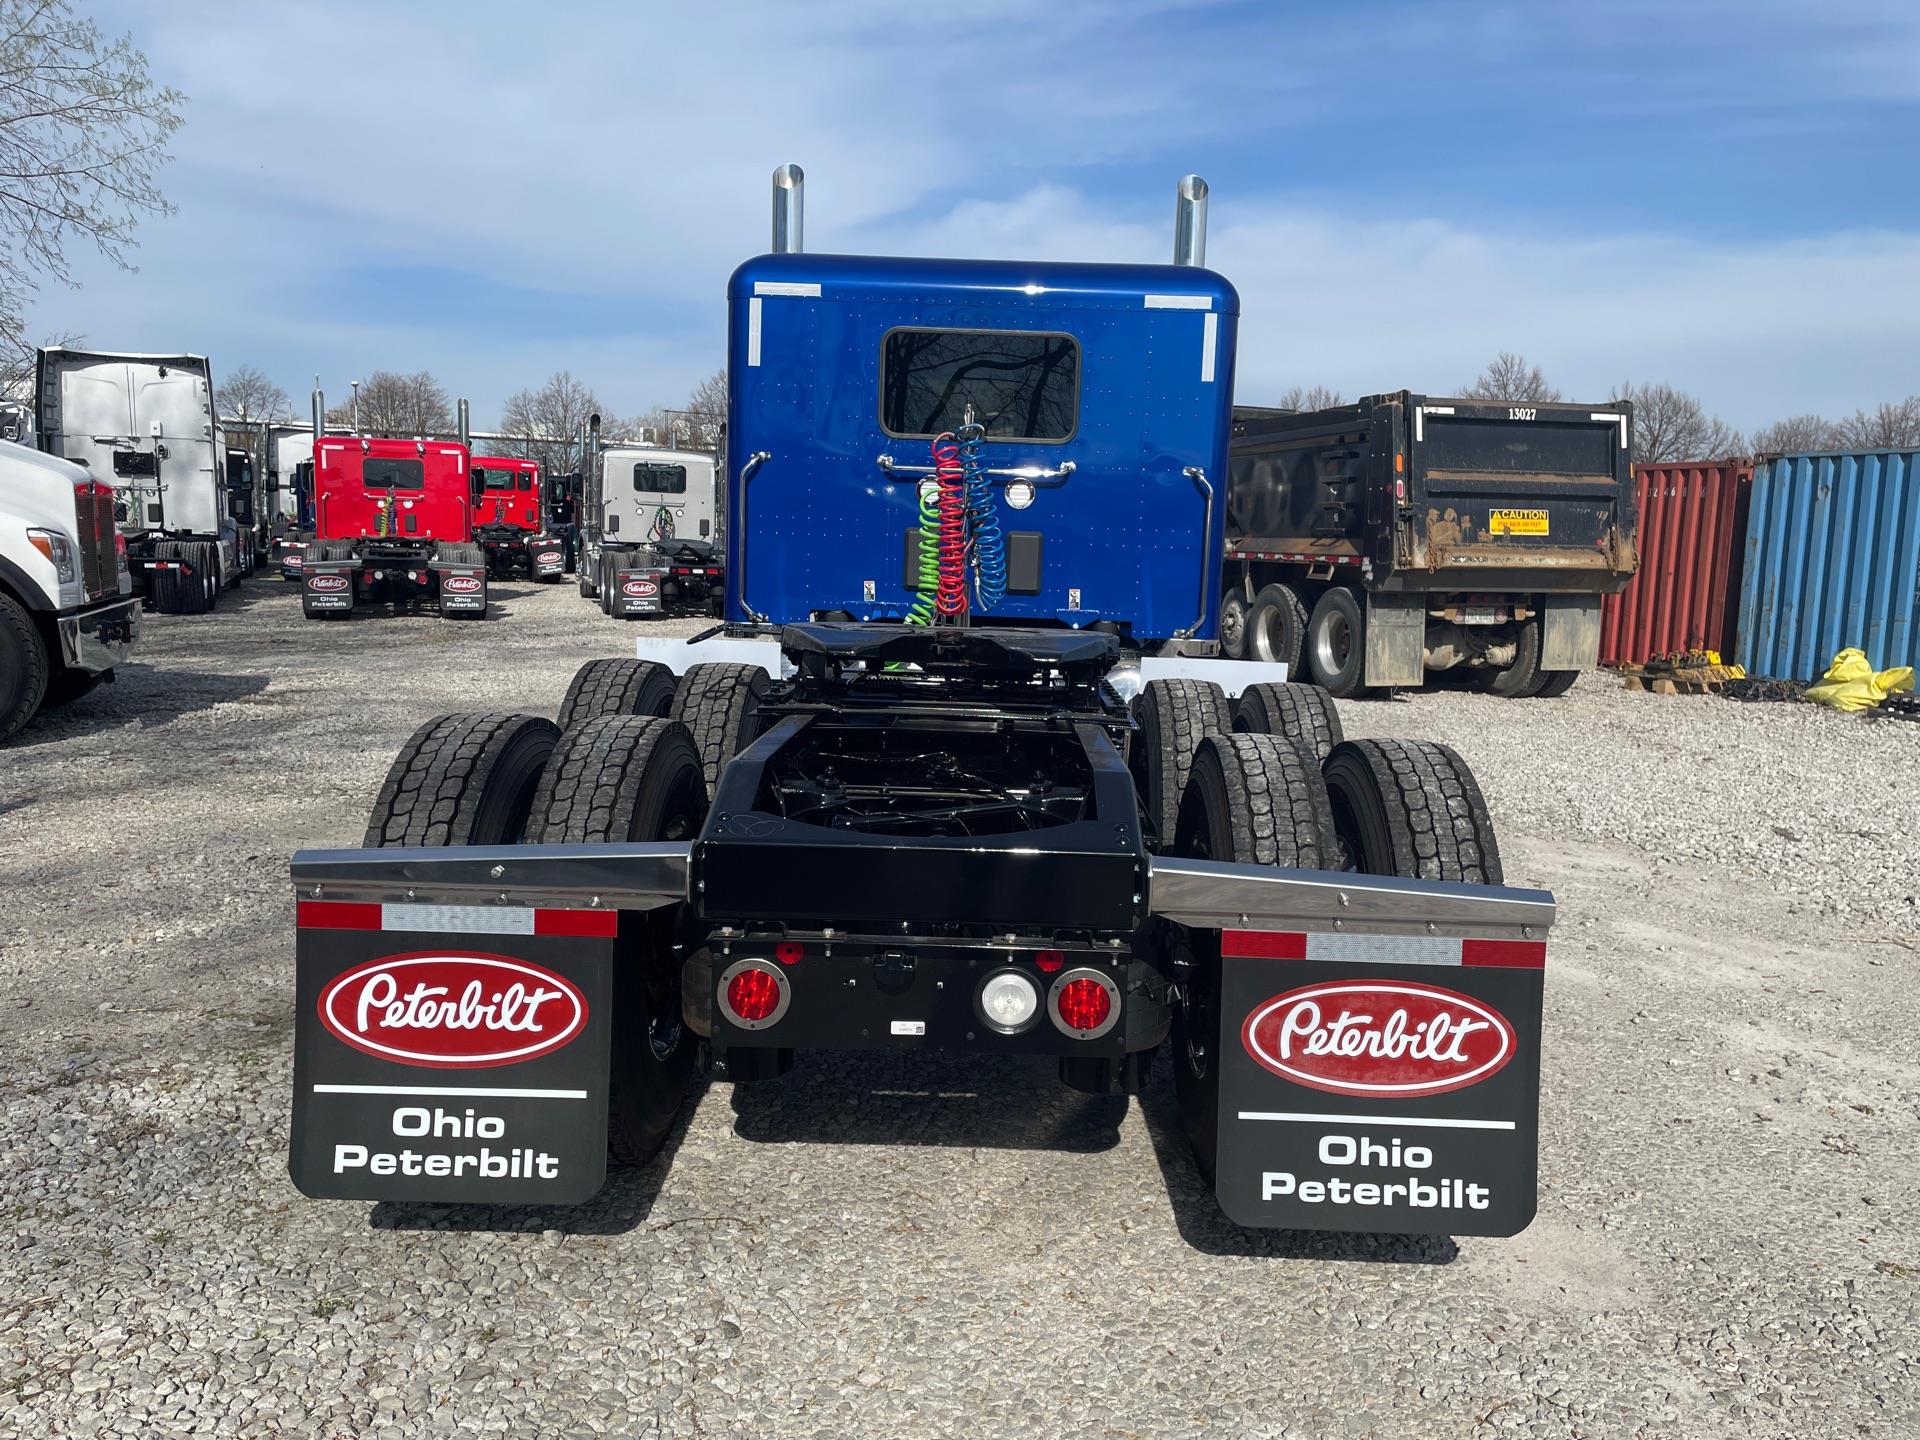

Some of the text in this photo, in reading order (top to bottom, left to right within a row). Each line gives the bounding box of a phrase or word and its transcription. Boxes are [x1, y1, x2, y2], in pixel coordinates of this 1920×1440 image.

[1509, 407, 1536, 420] 13027
[1501, 510, 1546, 519] CAUTION
[313, 579, 342, 588] Peterbilt
[448, 580, 476, 588] Peterbilt
[627, 582, 653, 592] Peterbilt
[357, 972, 563, 1033] Peterbilt
[1279, 1000, 1490, 1062] Peterbilt
[392, 1106, 505, 1139] Ohio
[333, 1144, 559, 1179] Peterbilt
[1318, 1135, 1433, 1169] Ohio
[1261, 1171, 1490, 1209] Peterbilt
